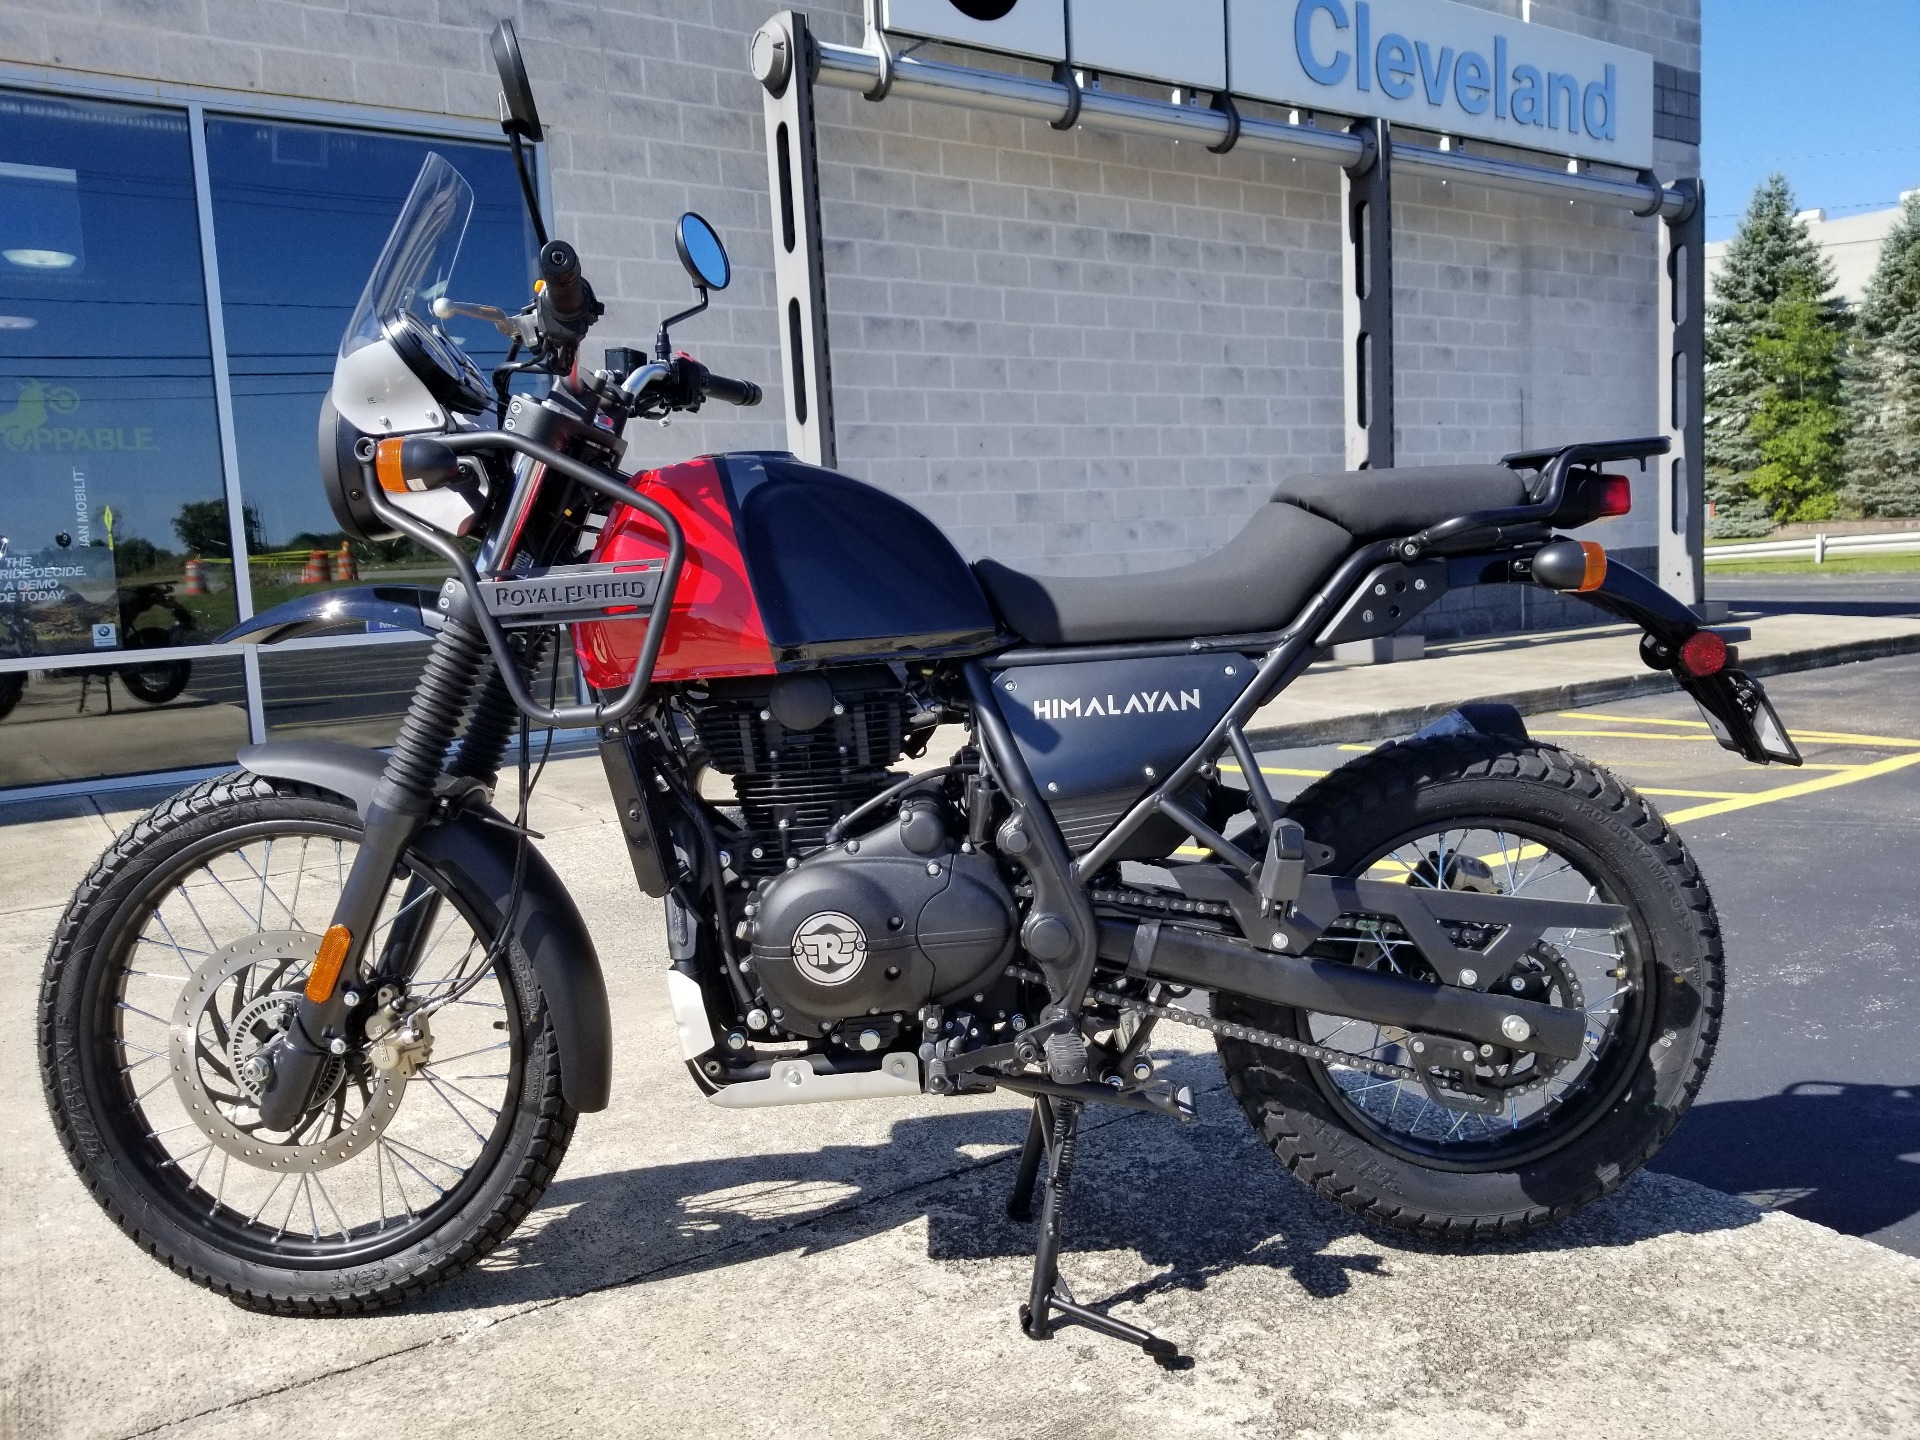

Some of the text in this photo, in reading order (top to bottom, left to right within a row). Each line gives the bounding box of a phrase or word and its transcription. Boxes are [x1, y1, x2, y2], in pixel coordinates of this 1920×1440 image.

[1294, 0, 1616, 142] Cleveland
[34, 566, 87, 577] DECIDE.
[3, 579, 59, 591] A DEMO
[20, 589, 66, 602] TODAY.
[1033, 688, 1200, 720] HIMALAYAN
